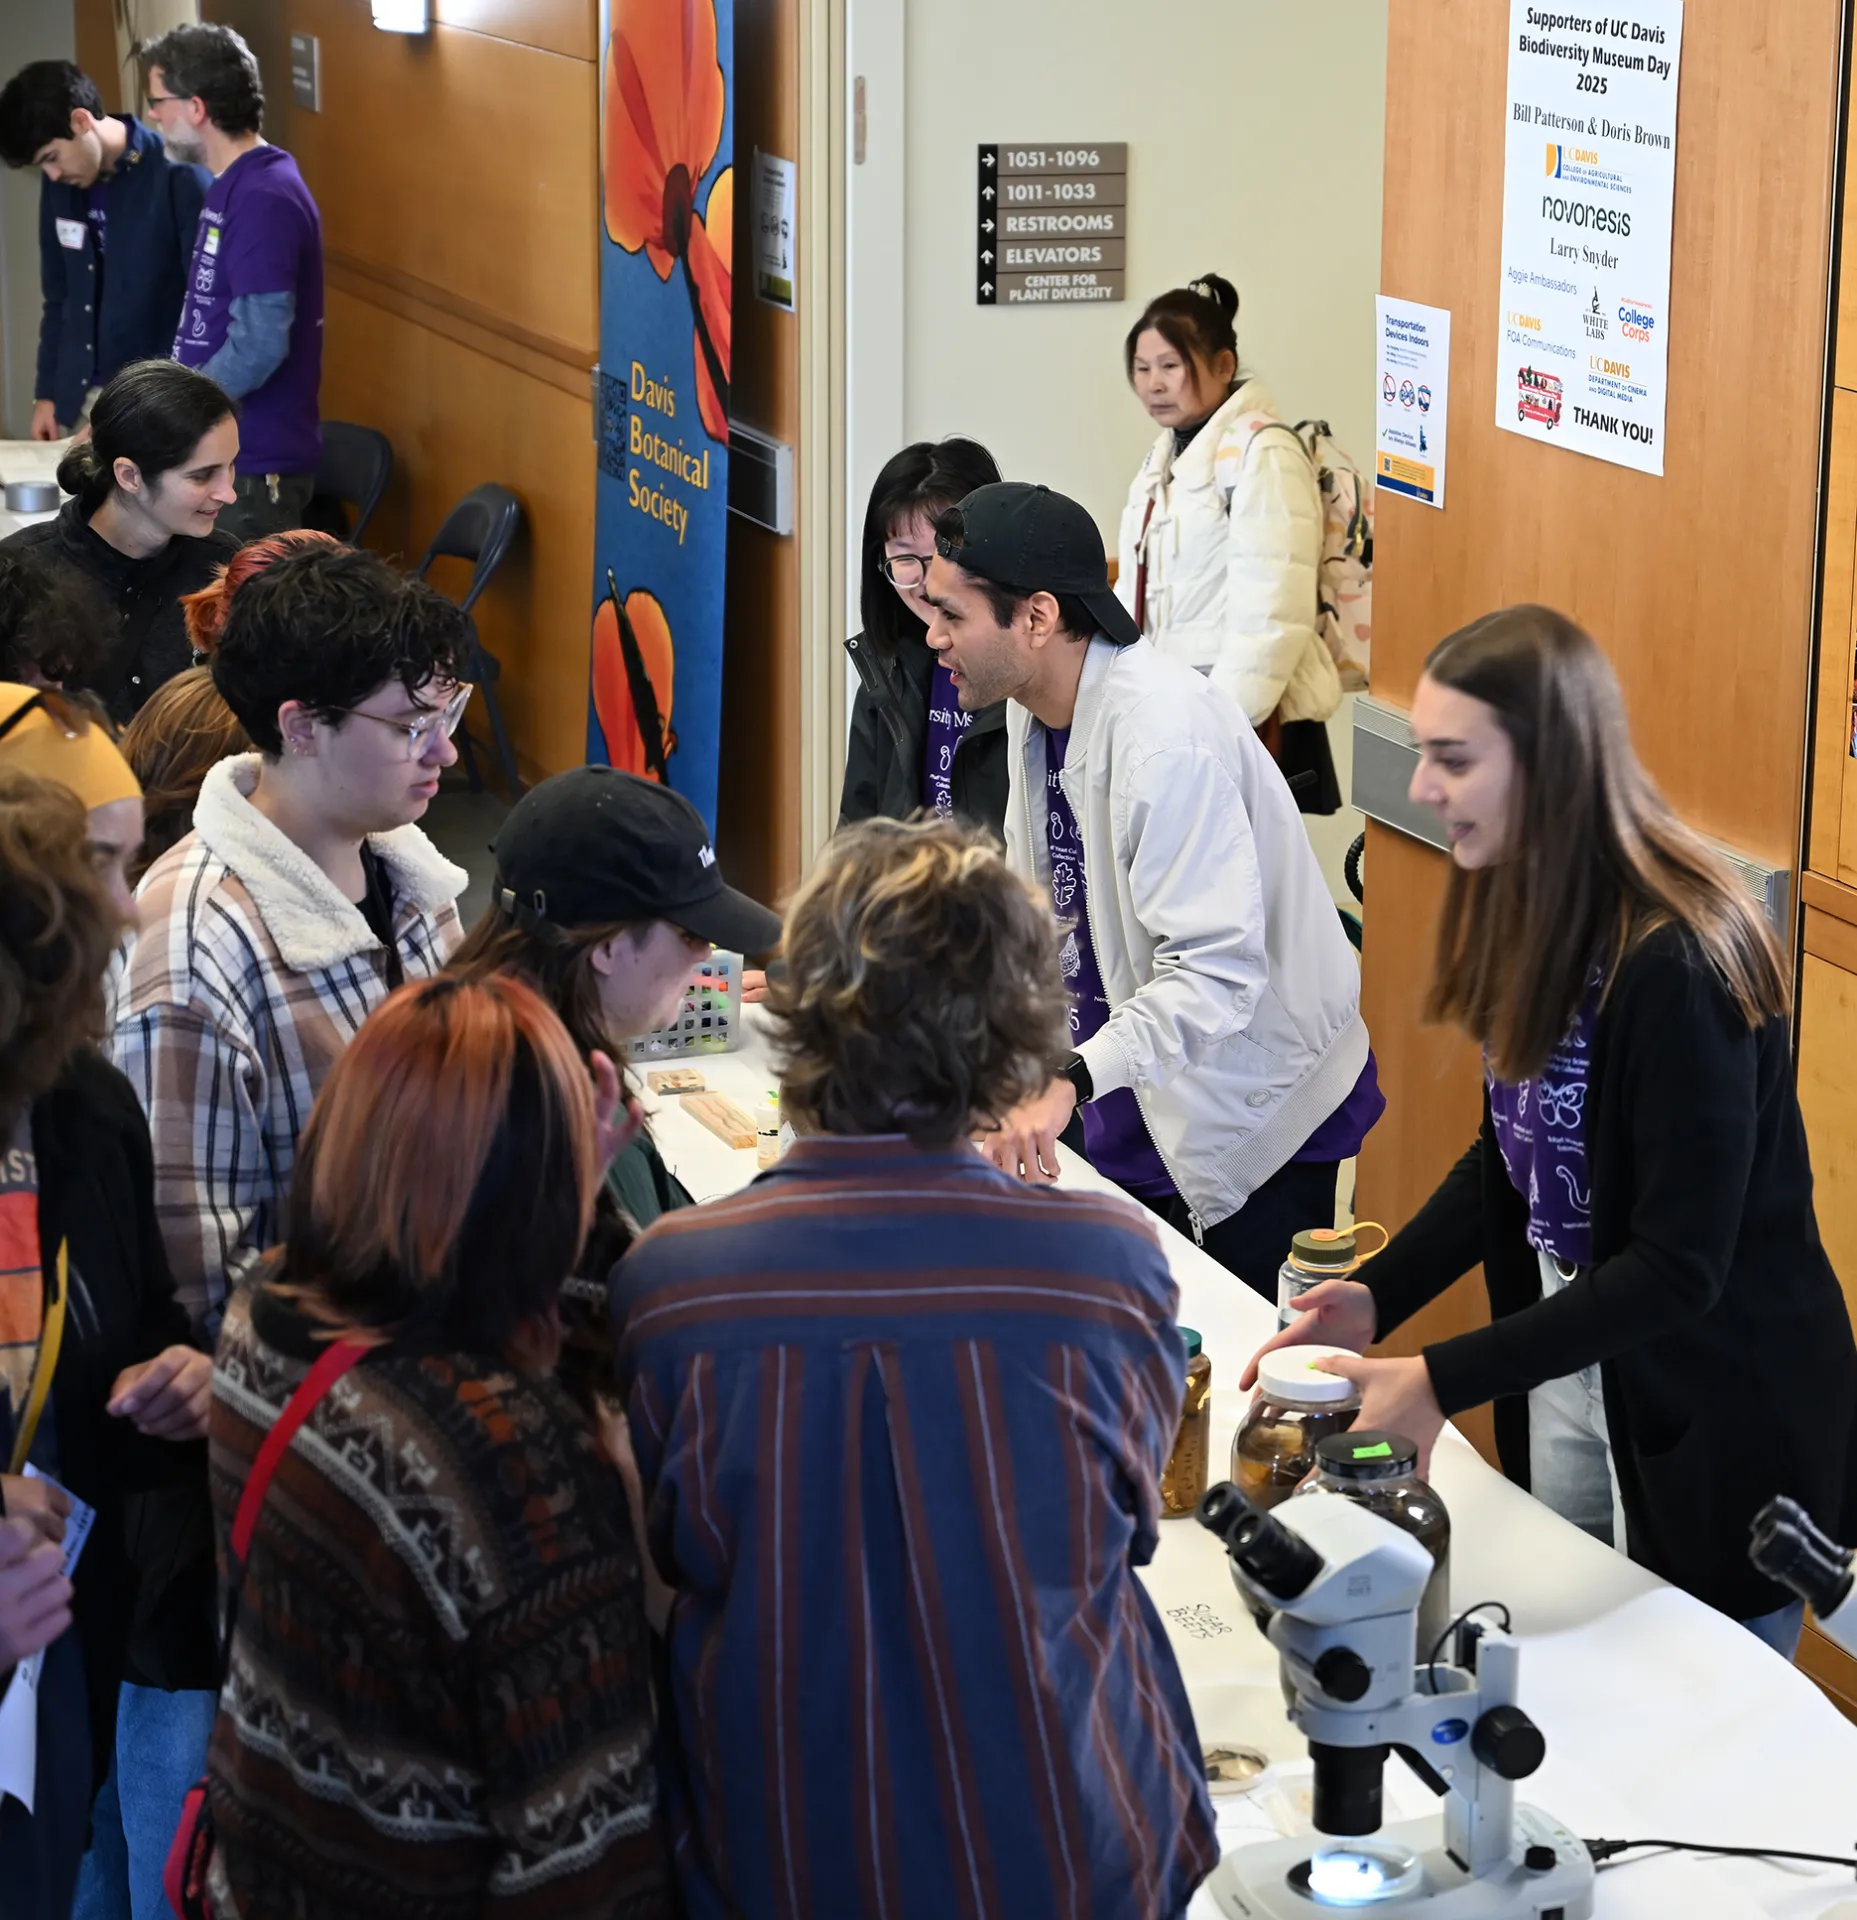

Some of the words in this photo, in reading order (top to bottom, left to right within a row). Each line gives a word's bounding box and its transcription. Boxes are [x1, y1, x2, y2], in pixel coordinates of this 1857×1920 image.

[1527, 7, 1592, 32] Supporters
[1595, 18, 1608, 35] of
[1610, 20, 1628, 38] UC
[1631, 22, 1665, 44] Davis
[1519, 35, 1589, 67] Biodiversity
[1592, 46, 1644, 71] Museum
[1647, 55, 1671, 80] Day
[1576, 73, 1608, 94] 2025
[1513, 102, 1531, 123] Bill
[1534, 106, 1584, 133] Patterson
[1588, 116, 1597, 135] &
[1601, 119, 1631, 142] Doris
[1634, 125, 1670, 149] Brown
[1007, 151, 1100, 167] 1051-1096
[1575, 149, 1598, 164] DAVIS
[1563, 164, 1582, 174] COLLEGE
[1588, 169, 1622, 182] AGRICULTURAL
[1007, 184, 1096, 200] 1011-1033
[1570, 175, 1608, 189] ENVIRONMENTAL
[1610, 183, 1632, 194] SCIENCES
[1006, 215, 1113, 232] RESTROOMS
[1542, 195, 1631, 237] novonesis
[1006, 247, 1102, 264] ELEVATORS
[1550, 237, 1580, 264] Larry
[1582, 245, 1619, 269] Snyder
[1025, 276, 1069, 287] CENTER
[1072, 274, 1096, 286] FOR
[1508, 266, 1528, 284] Aggie
[1529, 273, 1577, 295] Ambassadors
[1009, 288, 1049, 300] PLANT
[1052, 287, 1112, 299] DIVERSITY
[1386, 314, 1426, 332] Transportation
[1519, 315, 1542, 331] DAVIS
[1583, 314, 1608, 330] WHITE
[1618, 306, 1654, 329] College
[1386, 328, 1407, 341] Devices
[1409, 333, 1429, 347] Indoors
[1586, 326, 1605, 340] LABS
[1622, 324, 1650, 343] Corps
[1507, 329, 1520, 343] FOA
[1522, 335, 1576, 359] Communications
[1604, 359, 1630, 378] DAVIS
[631, 360, 676, 418] Davis
[1589, 374, 1621, 390] DEPARTMENT
[1628, 385, 1647, 396] CINEMA
[1598, 388, 1616, 399] DIGITAL
[1617, 392, 1633, 403] MEDIA
[1573, 406, 1618, 435] THANK
[1622, 421, 1653, 445] YOU!
[630, 414, 708, 490] Botanical
[629, 468, 688, 546] Society
[1166, 1607, 1214, 1640] BEETS
[1186, 1603, 1232, 1635] SUGAR
